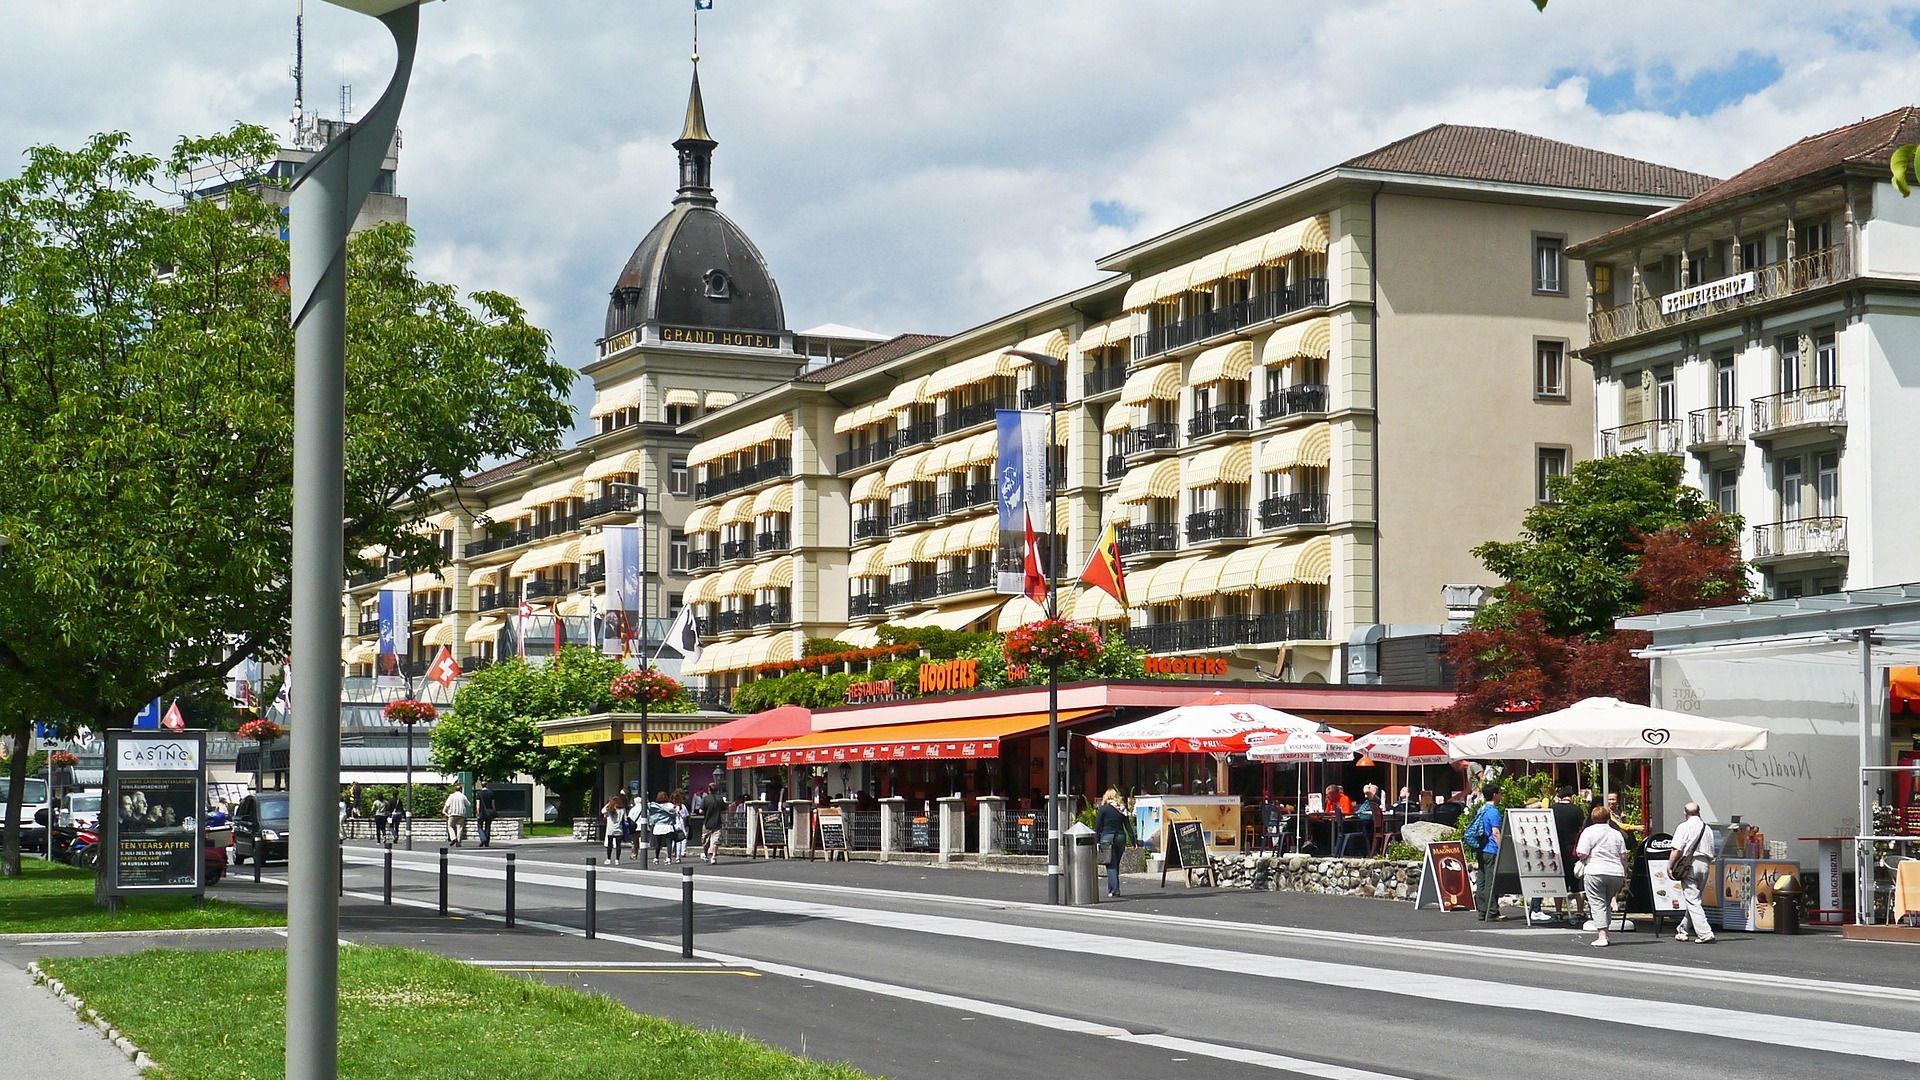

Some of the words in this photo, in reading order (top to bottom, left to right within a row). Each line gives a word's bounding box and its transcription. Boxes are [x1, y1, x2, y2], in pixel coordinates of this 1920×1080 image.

[663, 328, 715, 344] GRAND
[723, 334, 774, 348] HOTEL
[1144, 656, 1228, 675] HOOTERS
[919, 657, 978, 693] HOOTERS
[123, 750, 190, 761] CASINO
[120, 841, 136, 849] TEN
[137, 841, 163, 849] YEARS
[164, 841, 190, 849] AFTER
[1432, 847, 1461, 855] MAGNUM
[1726, 866, 1739, 883] Art
[1757, 867, 1778, 887] Art
